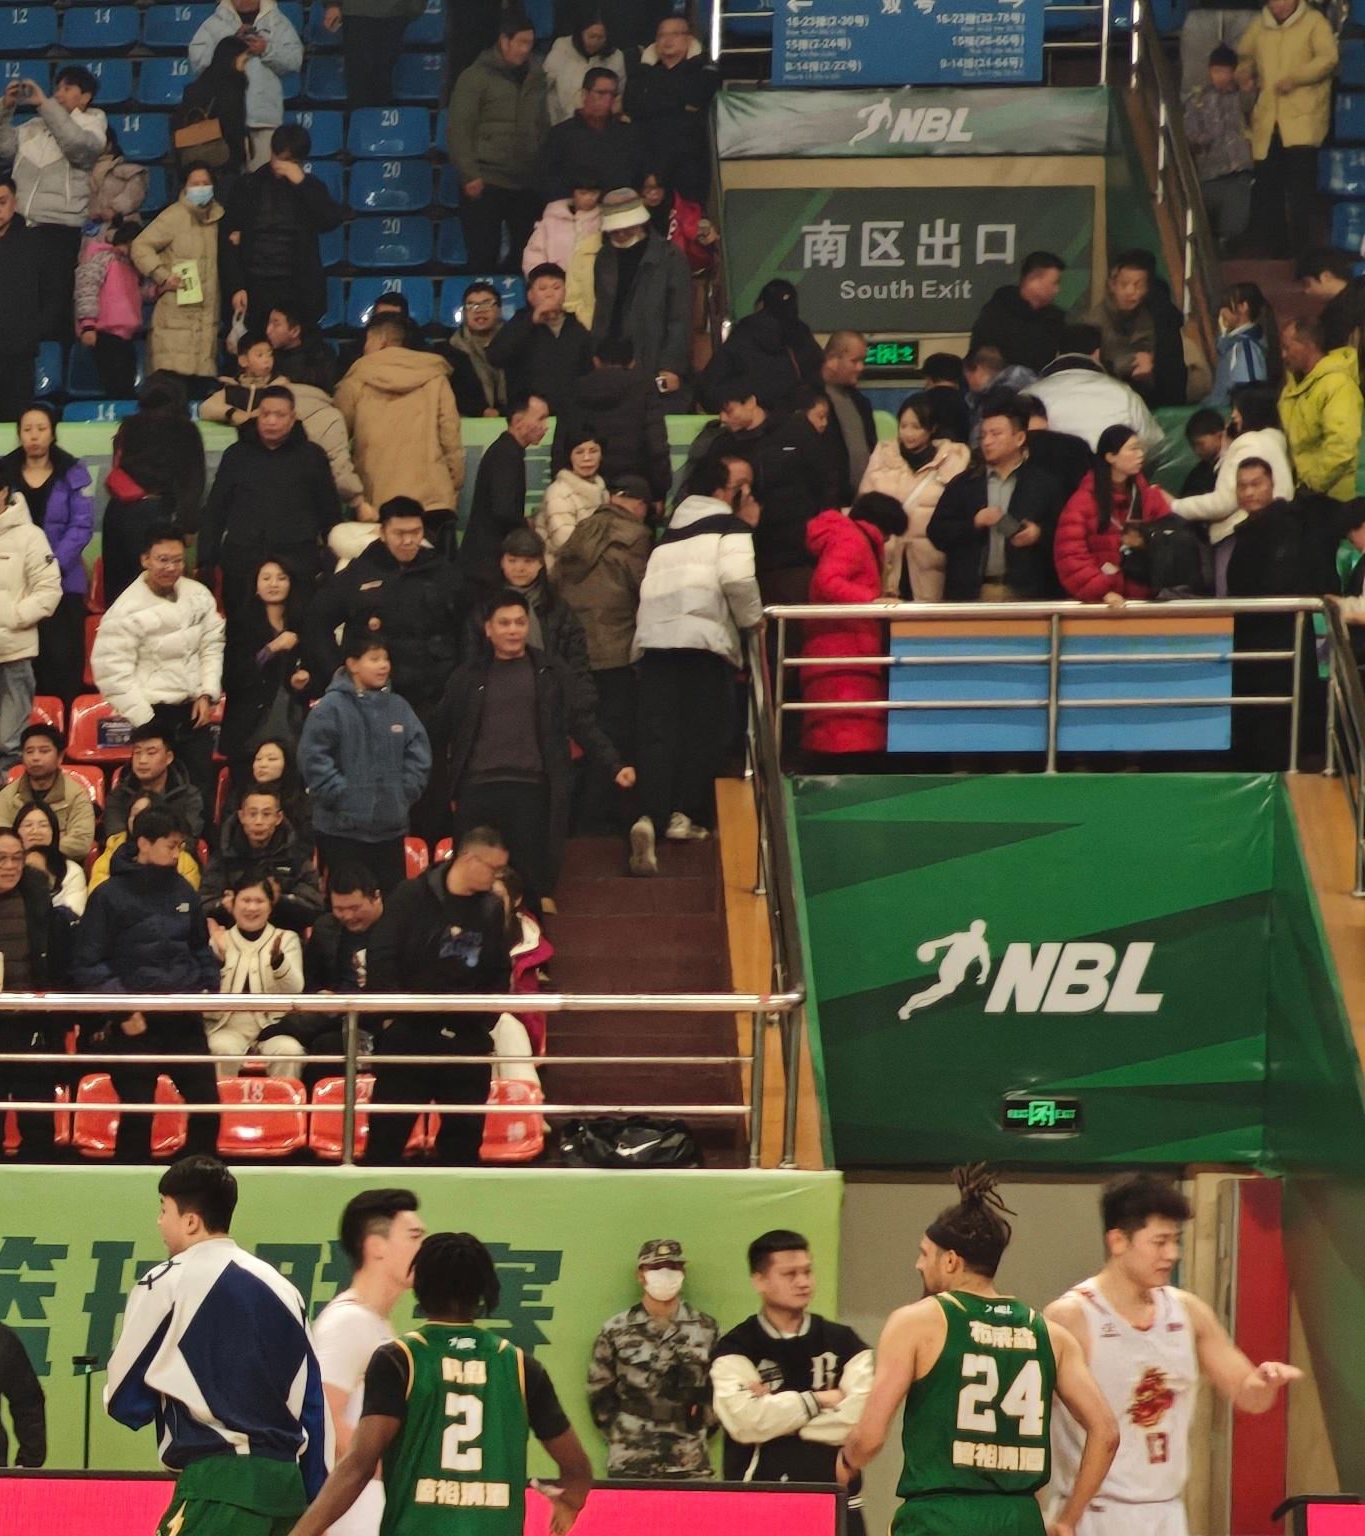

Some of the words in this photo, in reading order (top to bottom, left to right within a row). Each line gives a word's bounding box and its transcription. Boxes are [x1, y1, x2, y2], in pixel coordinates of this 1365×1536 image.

[12, 8, 28, 25] 12
[94, 8, 112, 25] 14
[381, 109, 400, 127] 20
[888, 106, 975, 143] NBL
[382, 160, 401, 178] 20
[801, 217, 1017, 269] 南区出口
[839, 279, 915, 300] South
[921, 279, 973, 300] Exit
[983, 941, 1164, 1014] NBL
[240, 1079, 264, 1103] 18
[956, 1352, 1045, 1436] 24
[440, 1391, 484, 1472] 2
